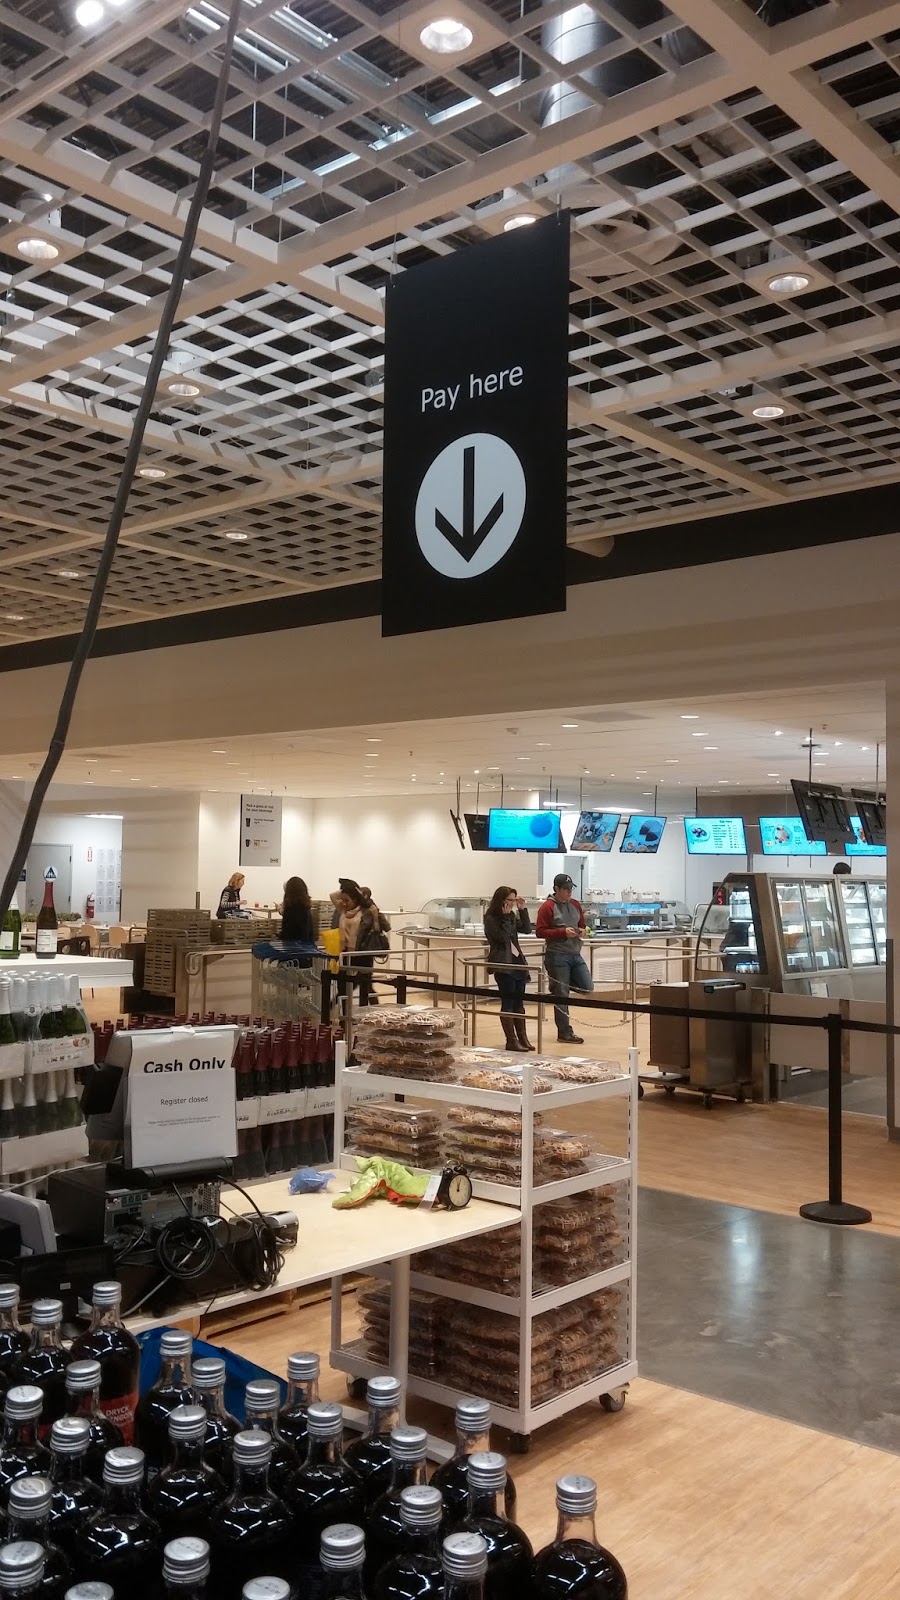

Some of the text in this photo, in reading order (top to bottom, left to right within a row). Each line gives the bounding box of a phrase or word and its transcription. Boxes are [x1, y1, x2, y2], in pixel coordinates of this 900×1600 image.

[421, 366, 523, 412] Pay here
[143, 1059, 183, 1074] Cash
[160, 1095, 209, 1107] Register closed
[105, 1405, 129, 1416] DRYCK
